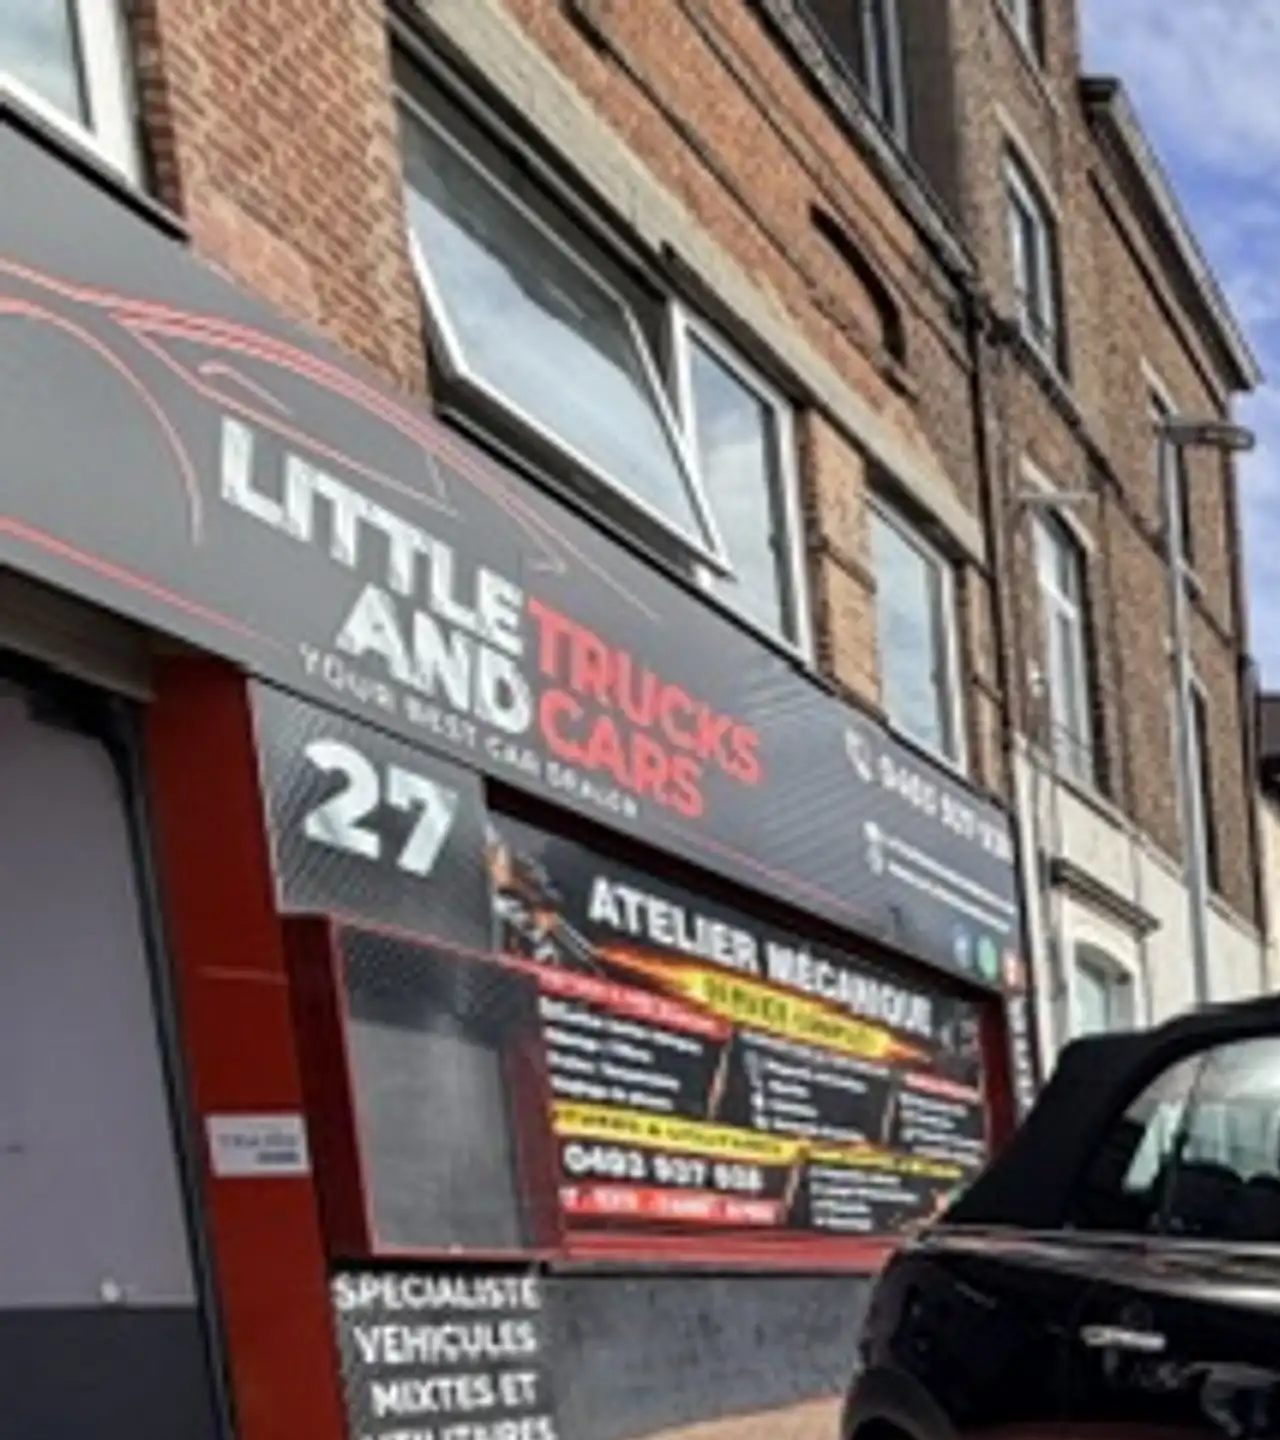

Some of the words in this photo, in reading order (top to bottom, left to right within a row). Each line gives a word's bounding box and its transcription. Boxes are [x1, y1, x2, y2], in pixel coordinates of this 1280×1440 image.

[221, 414, 525, 656] LITTLE
[528, 596, 762, 786] TRUCKS
[335, 581, 531, 734] AND
[539, 689, 703, 818] CARS
[303, 737, 458, 877] 27
[588, 876, 761, 973] ATELIER
[331, 1271, 541, 1310] SPECIALISTE
[354, 1321, 537, 1364] VEHICULES
[371, 1375, 494, 1417] MIXTES
[499, 1372, 538, 1405] ET
